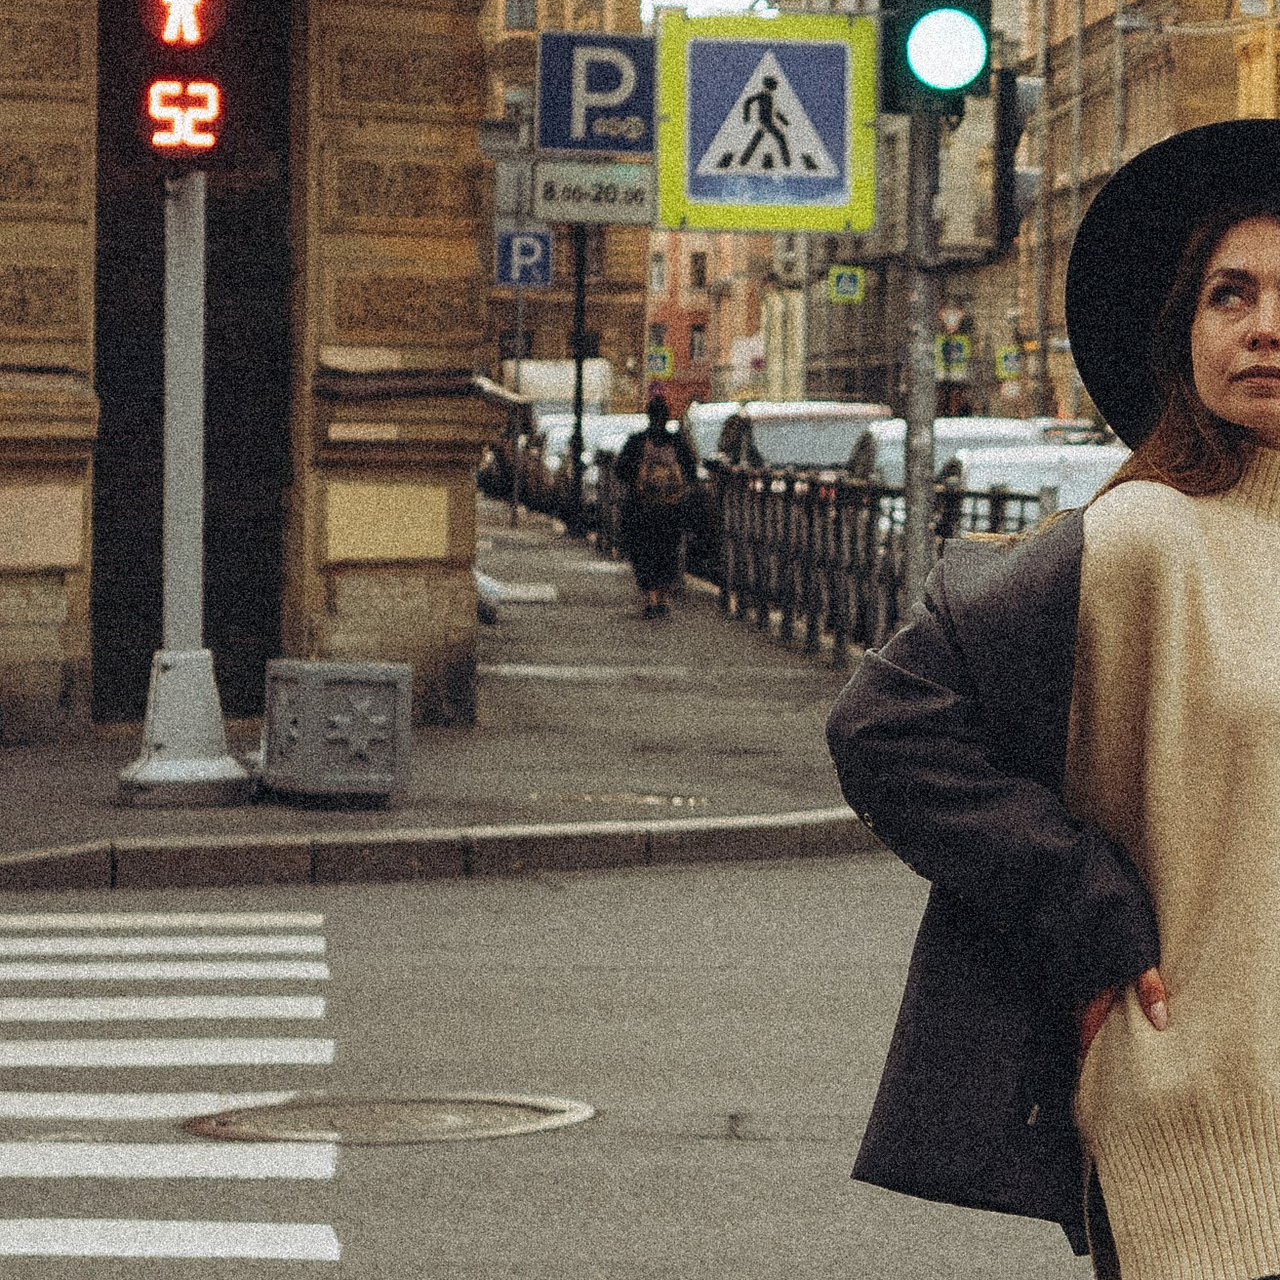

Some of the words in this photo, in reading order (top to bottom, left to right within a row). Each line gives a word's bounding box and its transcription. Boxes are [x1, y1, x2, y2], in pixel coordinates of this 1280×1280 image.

[148, 80, 220, 147] 52
[571, 47, 636, 139] P
[512, 237, 542, 279] P
